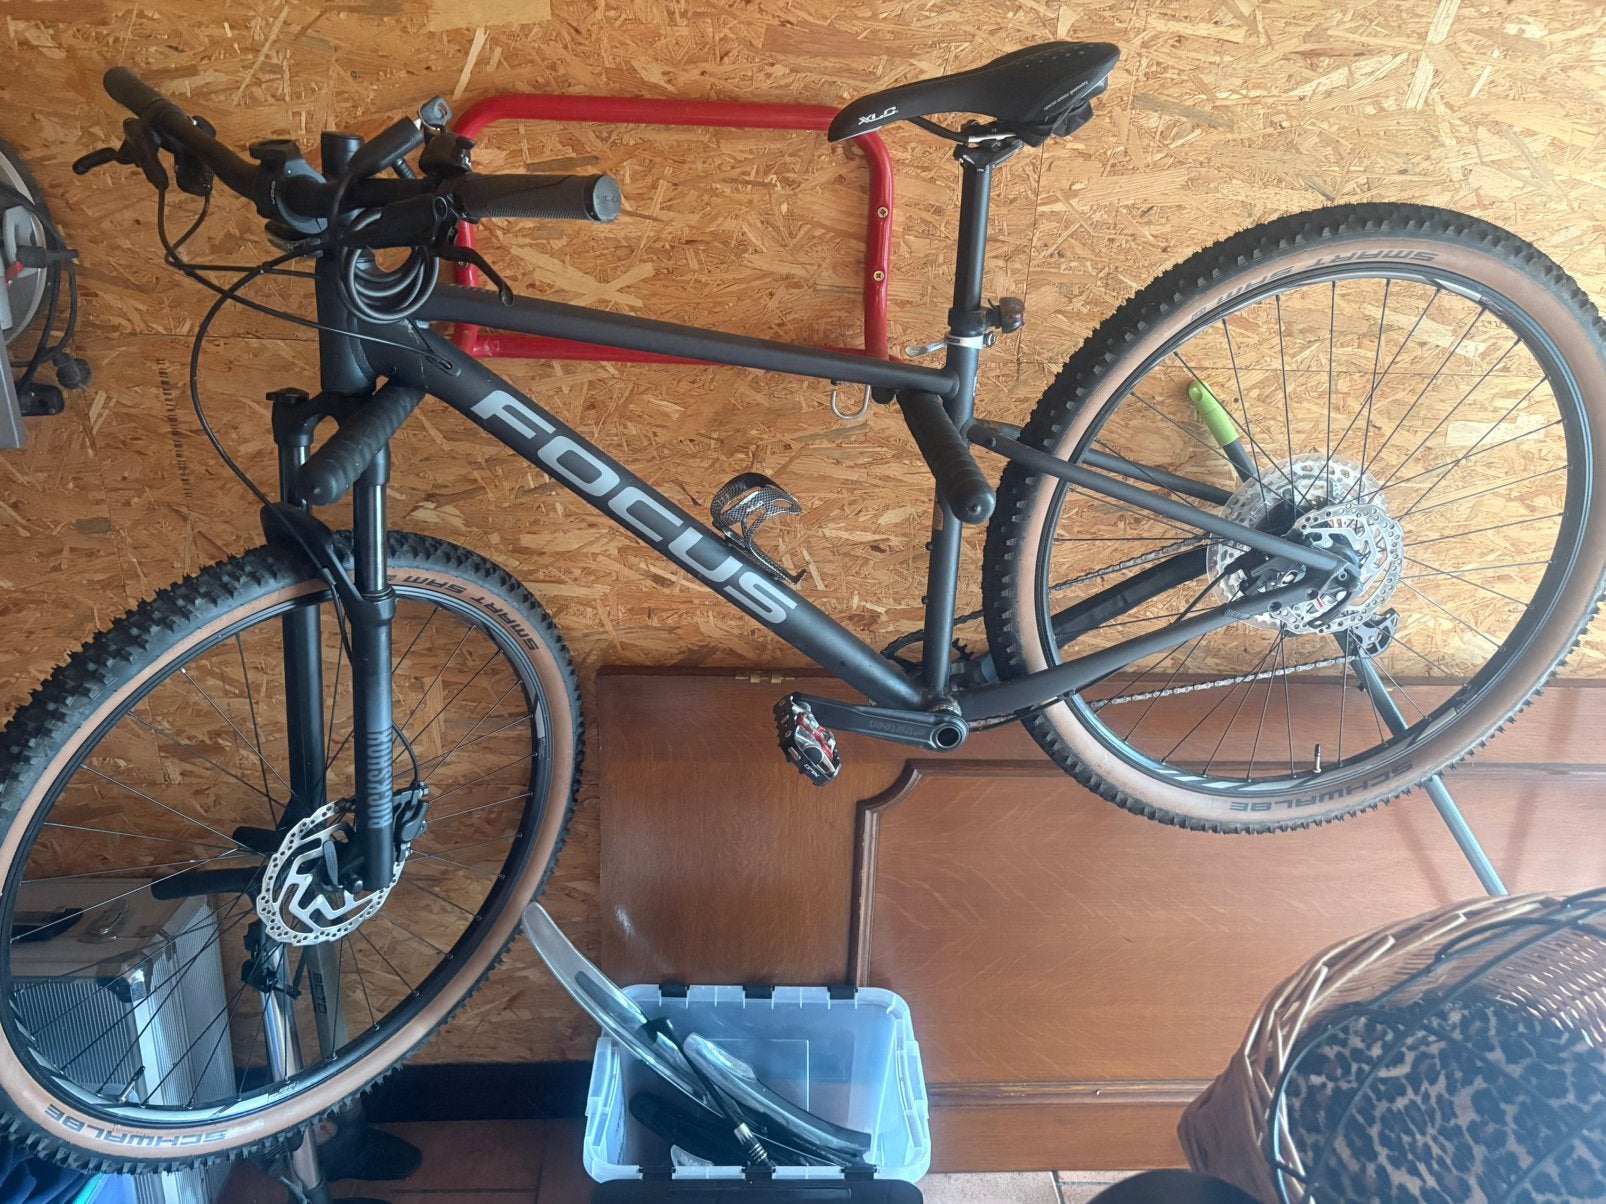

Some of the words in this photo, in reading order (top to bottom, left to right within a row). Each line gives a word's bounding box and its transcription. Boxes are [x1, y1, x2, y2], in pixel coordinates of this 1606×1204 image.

[858, 106, 898, 125] XLC
[1306, 250, 1439, 269] SMART
[470, 389, 798, 624] FOCUS
[402, 575, 468, 595] SAM
[471, 596, 540, 651] SMART
[366, 727, 393, 829] ROCKSHOX
[1229, 760, 1414, 812] SCHWALBE
[43, 1104, 228, 1147] SCHWALBE
